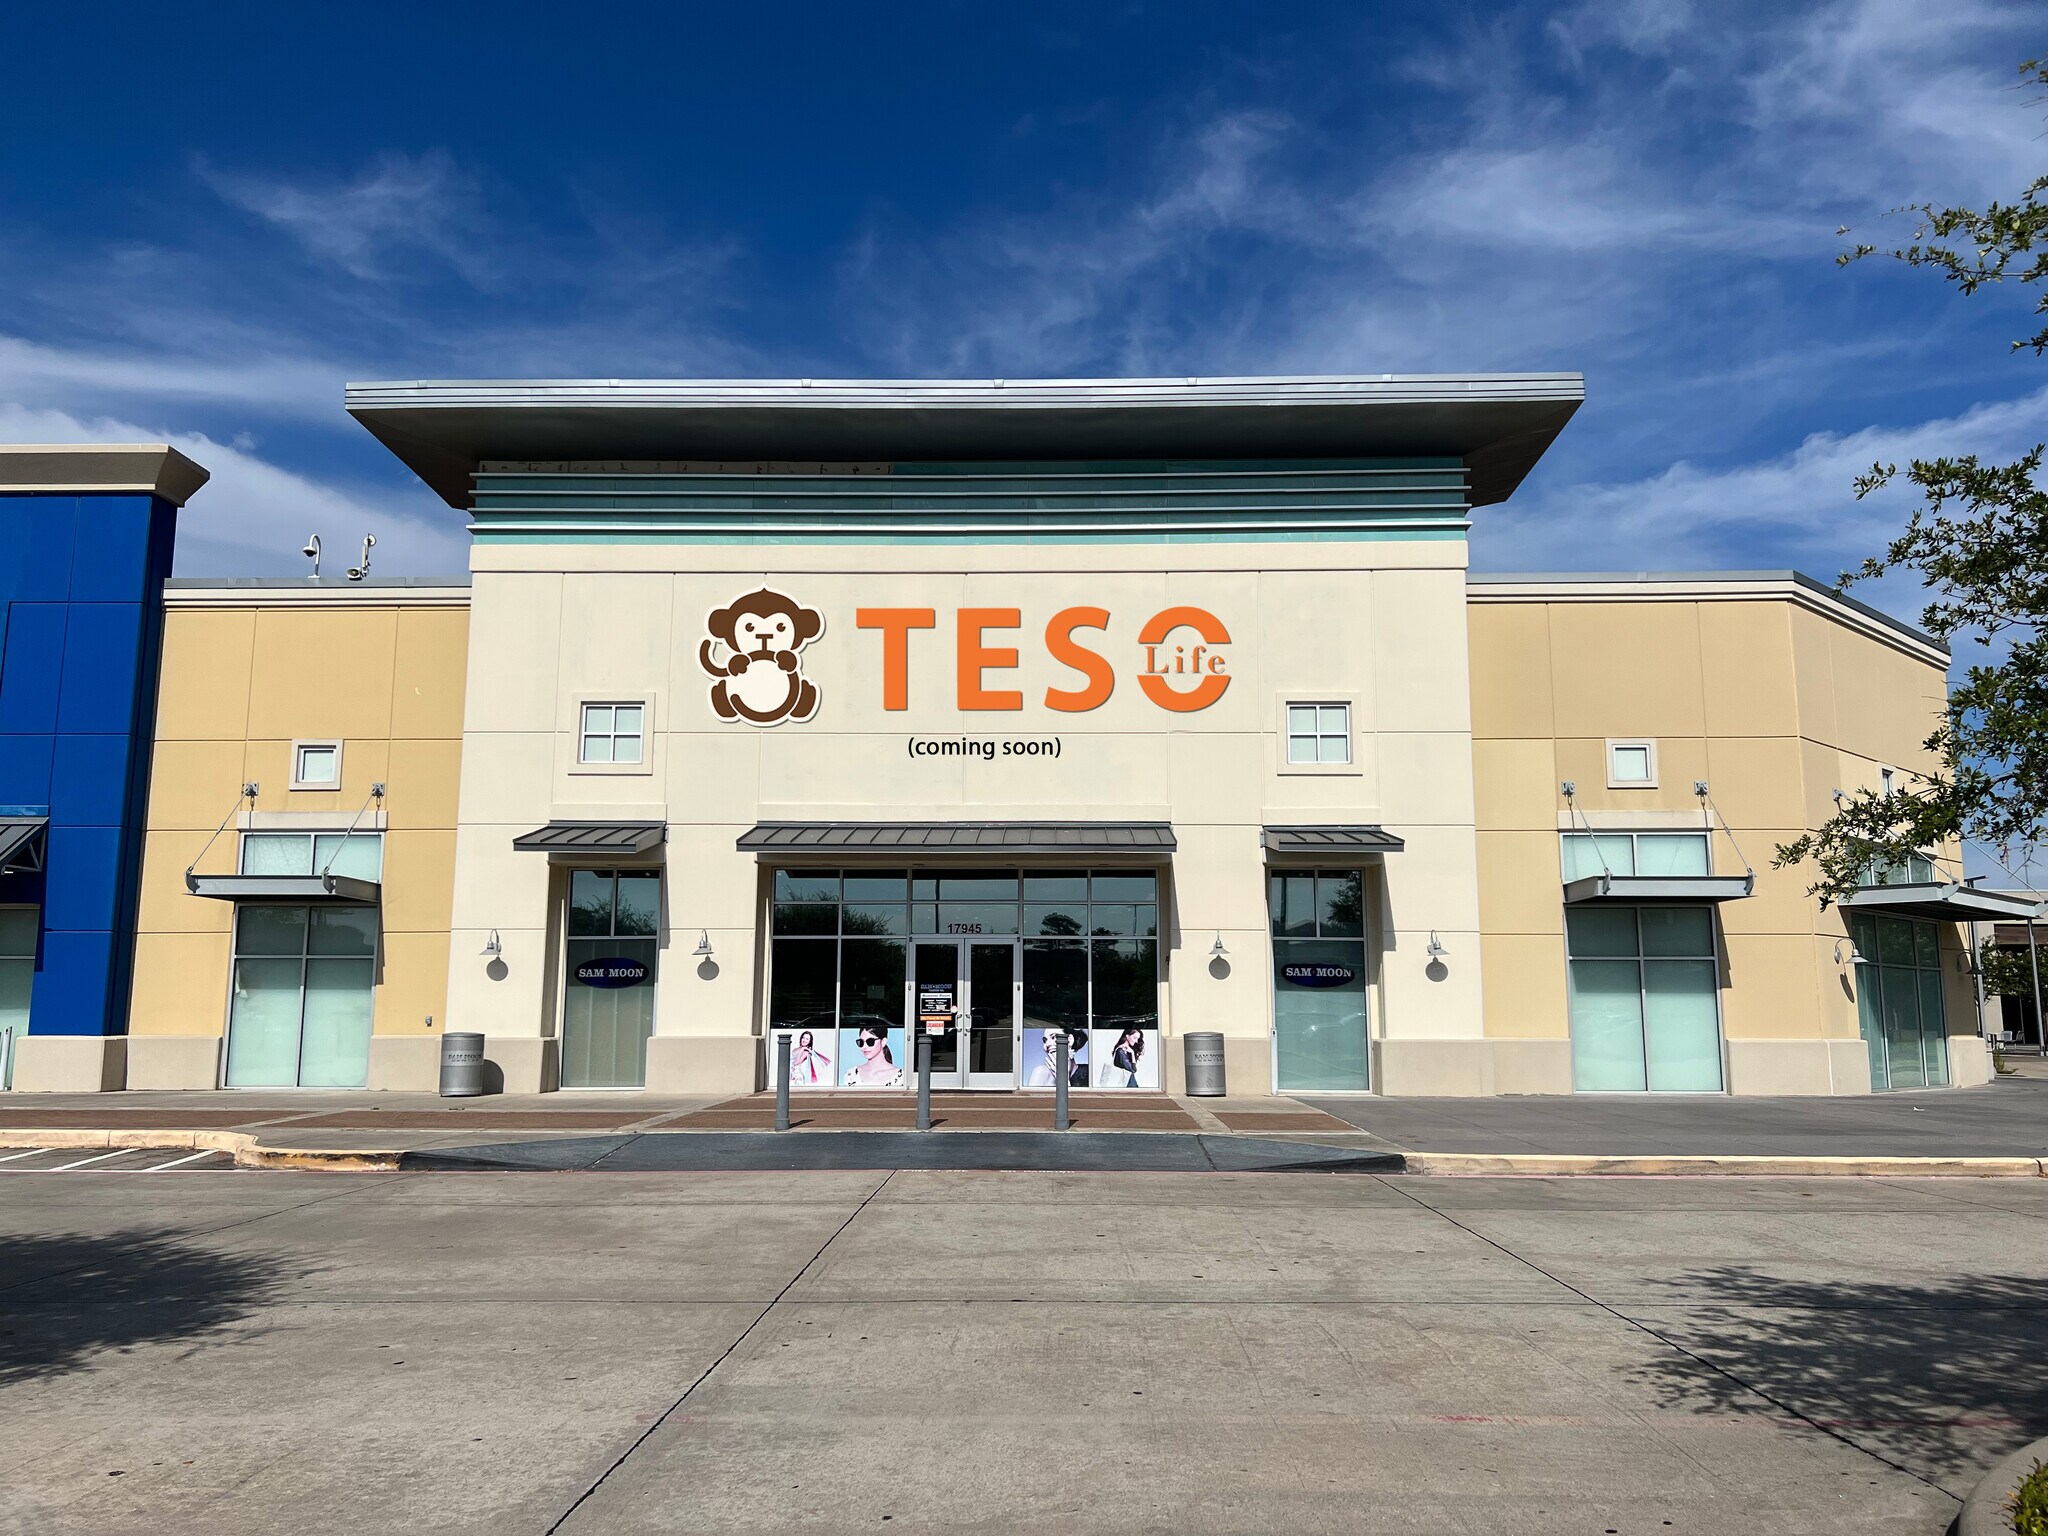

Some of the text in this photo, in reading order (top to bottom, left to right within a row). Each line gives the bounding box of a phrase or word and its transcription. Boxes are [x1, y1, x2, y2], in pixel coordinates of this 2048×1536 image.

[856, 606, 1232, 712] TESO
[1144, 645, 1226, 674] Life
[908, 737, 1061, 760] (coming soon)
[947, 923, 982, 934] 17945
[578, 968, 645, 978] SAM MOON
[1286, 967, 1352, 977] SAM MOON
